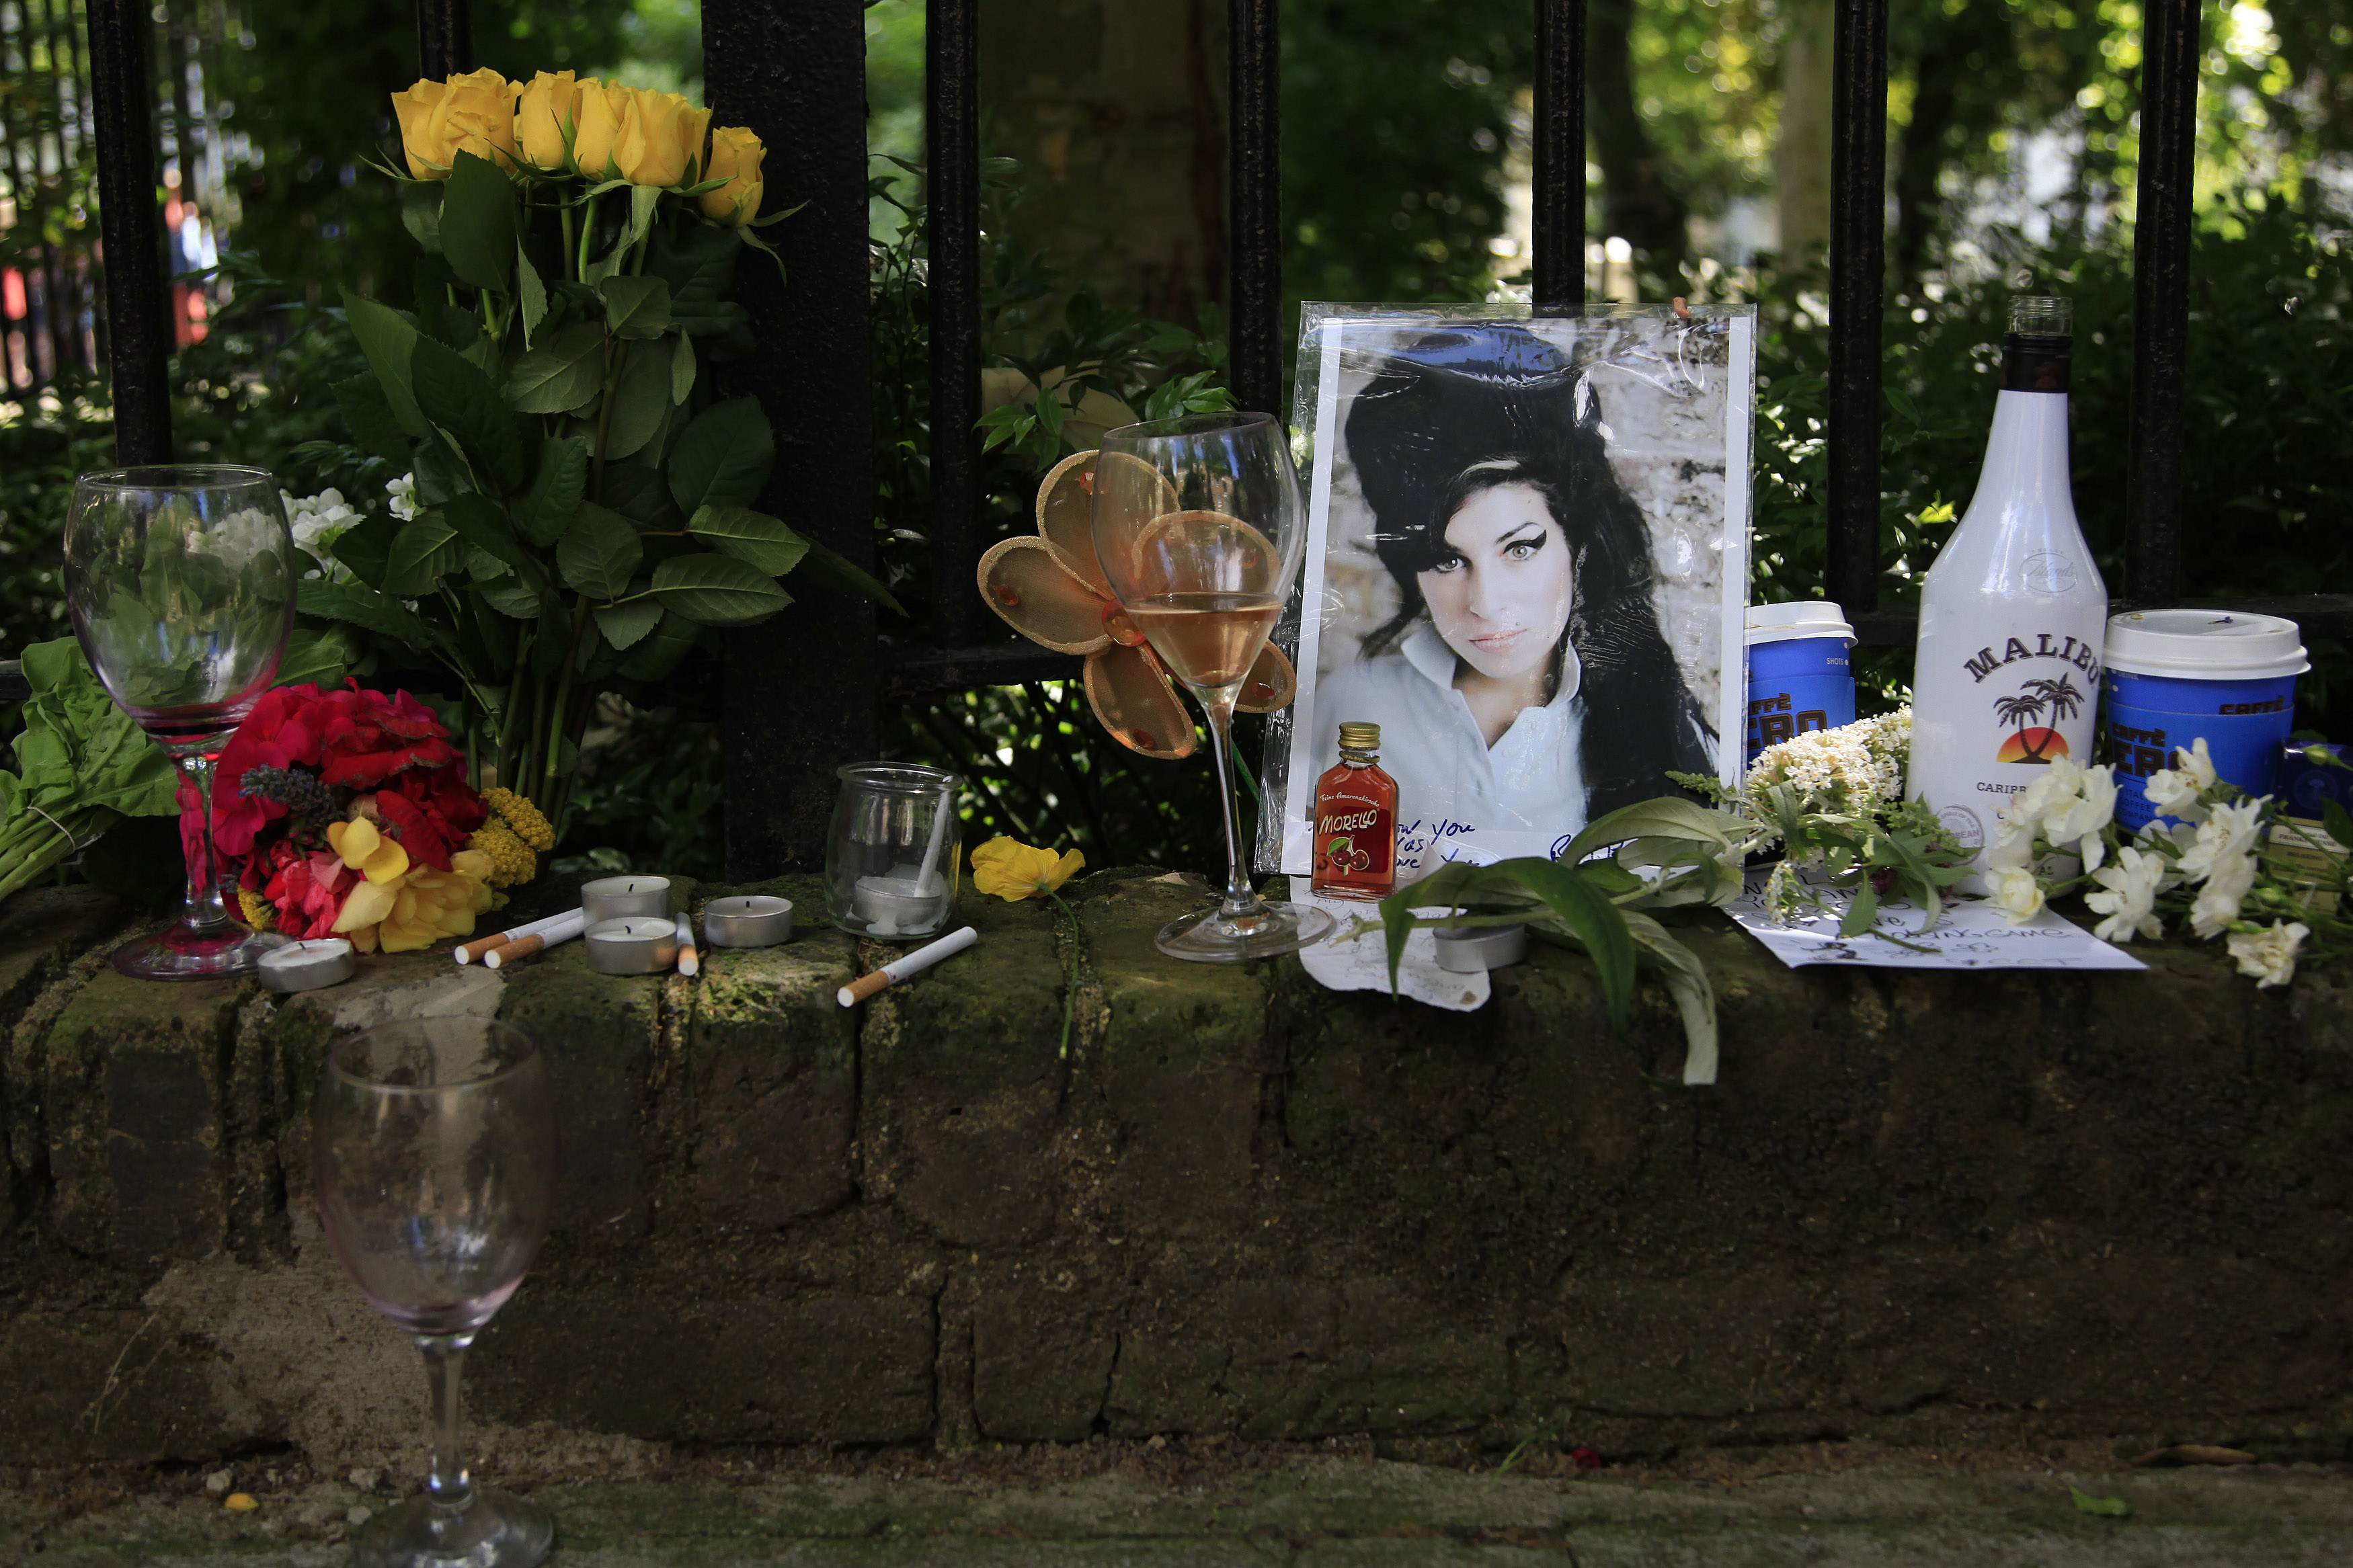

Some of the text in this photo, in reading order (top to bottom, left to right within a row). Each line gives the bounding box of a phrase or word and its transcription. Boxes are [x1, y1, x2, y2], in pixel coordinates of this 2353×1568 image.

[1826, 657, 1844, 665] SHOTS
[1962, 633, 2099, 685] MALIBU
[1977, 782, 2028, 794] CARIBB
[1320, 793, 1334, 802] Feine
[1319, 809, 1378, 835] MORELLO
